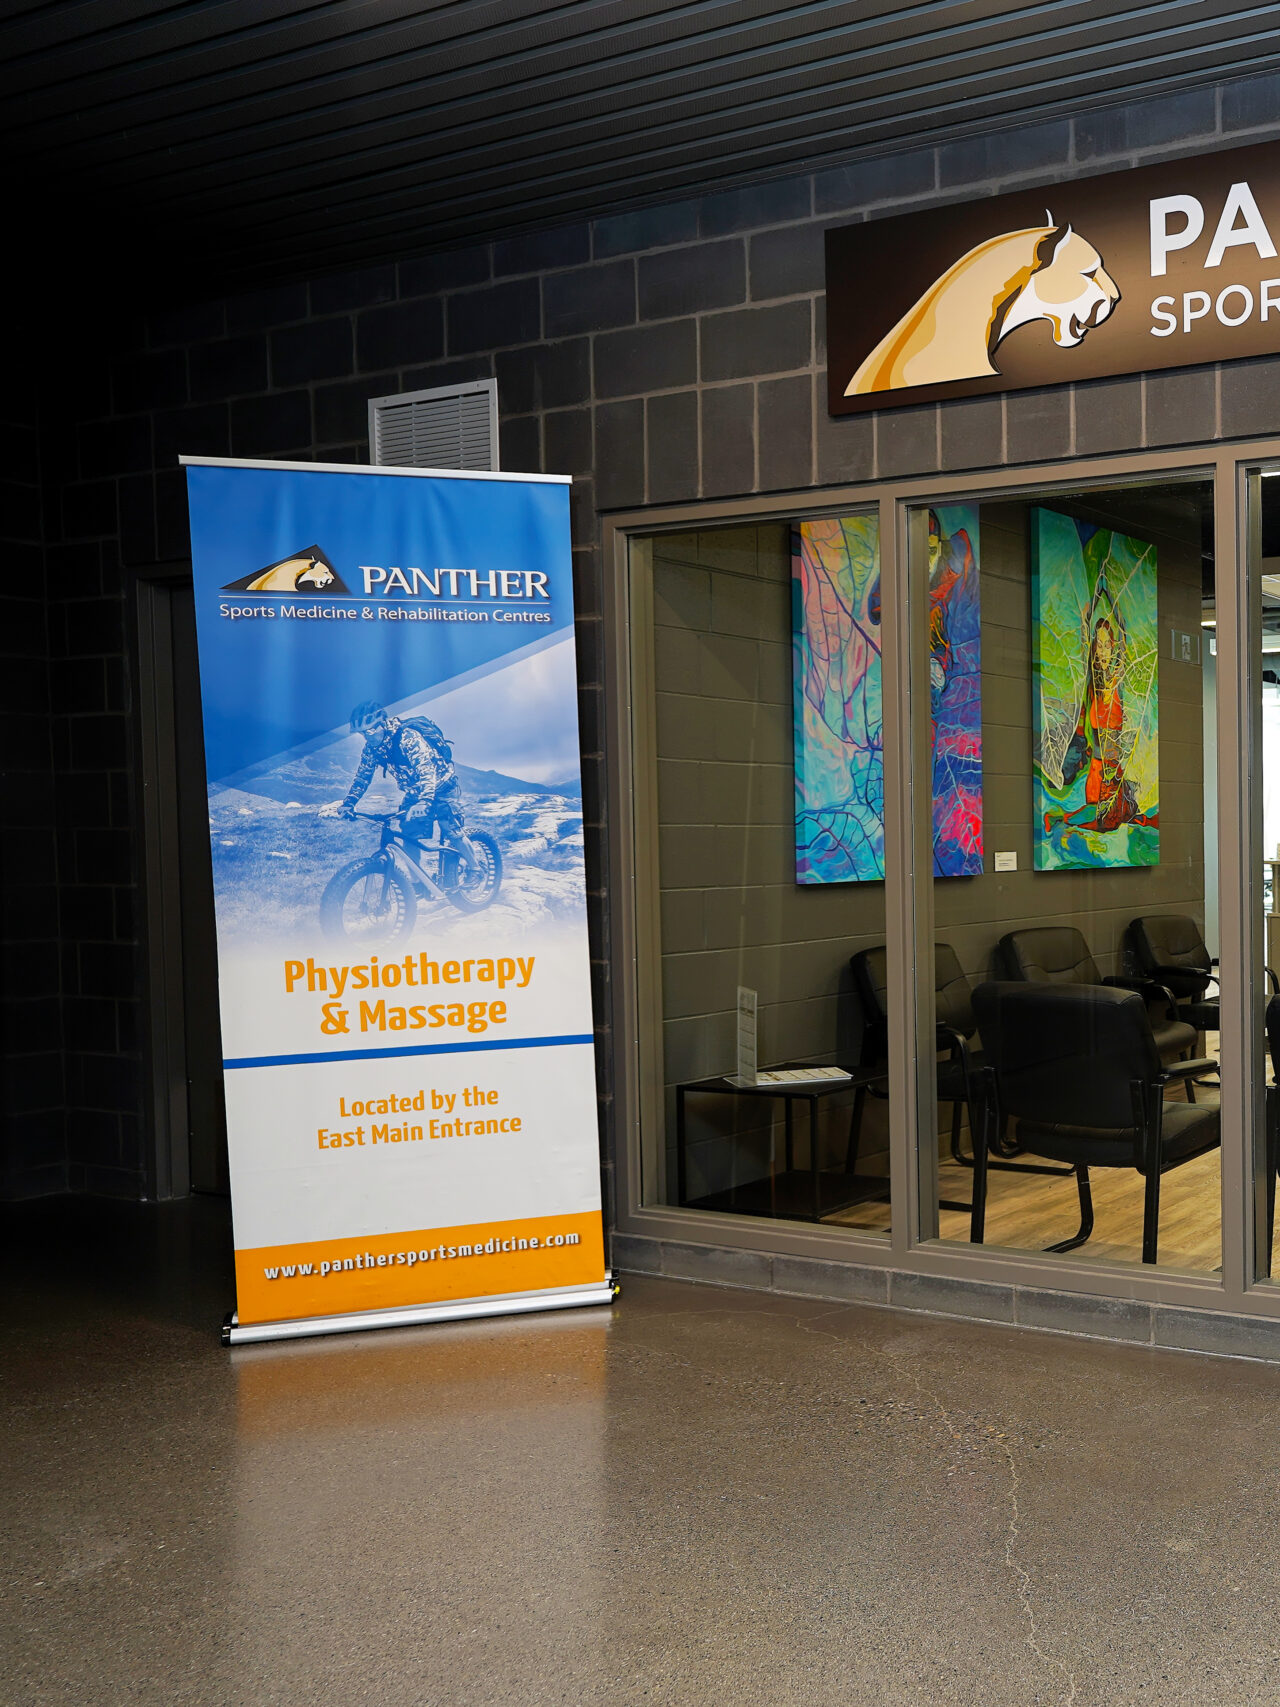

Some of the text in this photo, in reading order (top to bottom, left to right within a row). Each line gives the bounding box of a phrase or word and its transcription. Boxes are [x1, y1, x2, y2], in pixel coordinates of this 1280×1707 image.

[358, 566, 550, 598] PANTHER
[219, 603, 551, 622] Sports Medicine & Rehabilitation Centres
[284, 951, 536, 1000] Physiotherapy
[320, 1000, 507, 1035] & Massage
[339, 1085, 499, 1118] Located by the
[317, 1117, 522, 1150] East Main Entrance
[263, 1232, 580, 1280] www.panthersportsmedicine.com
